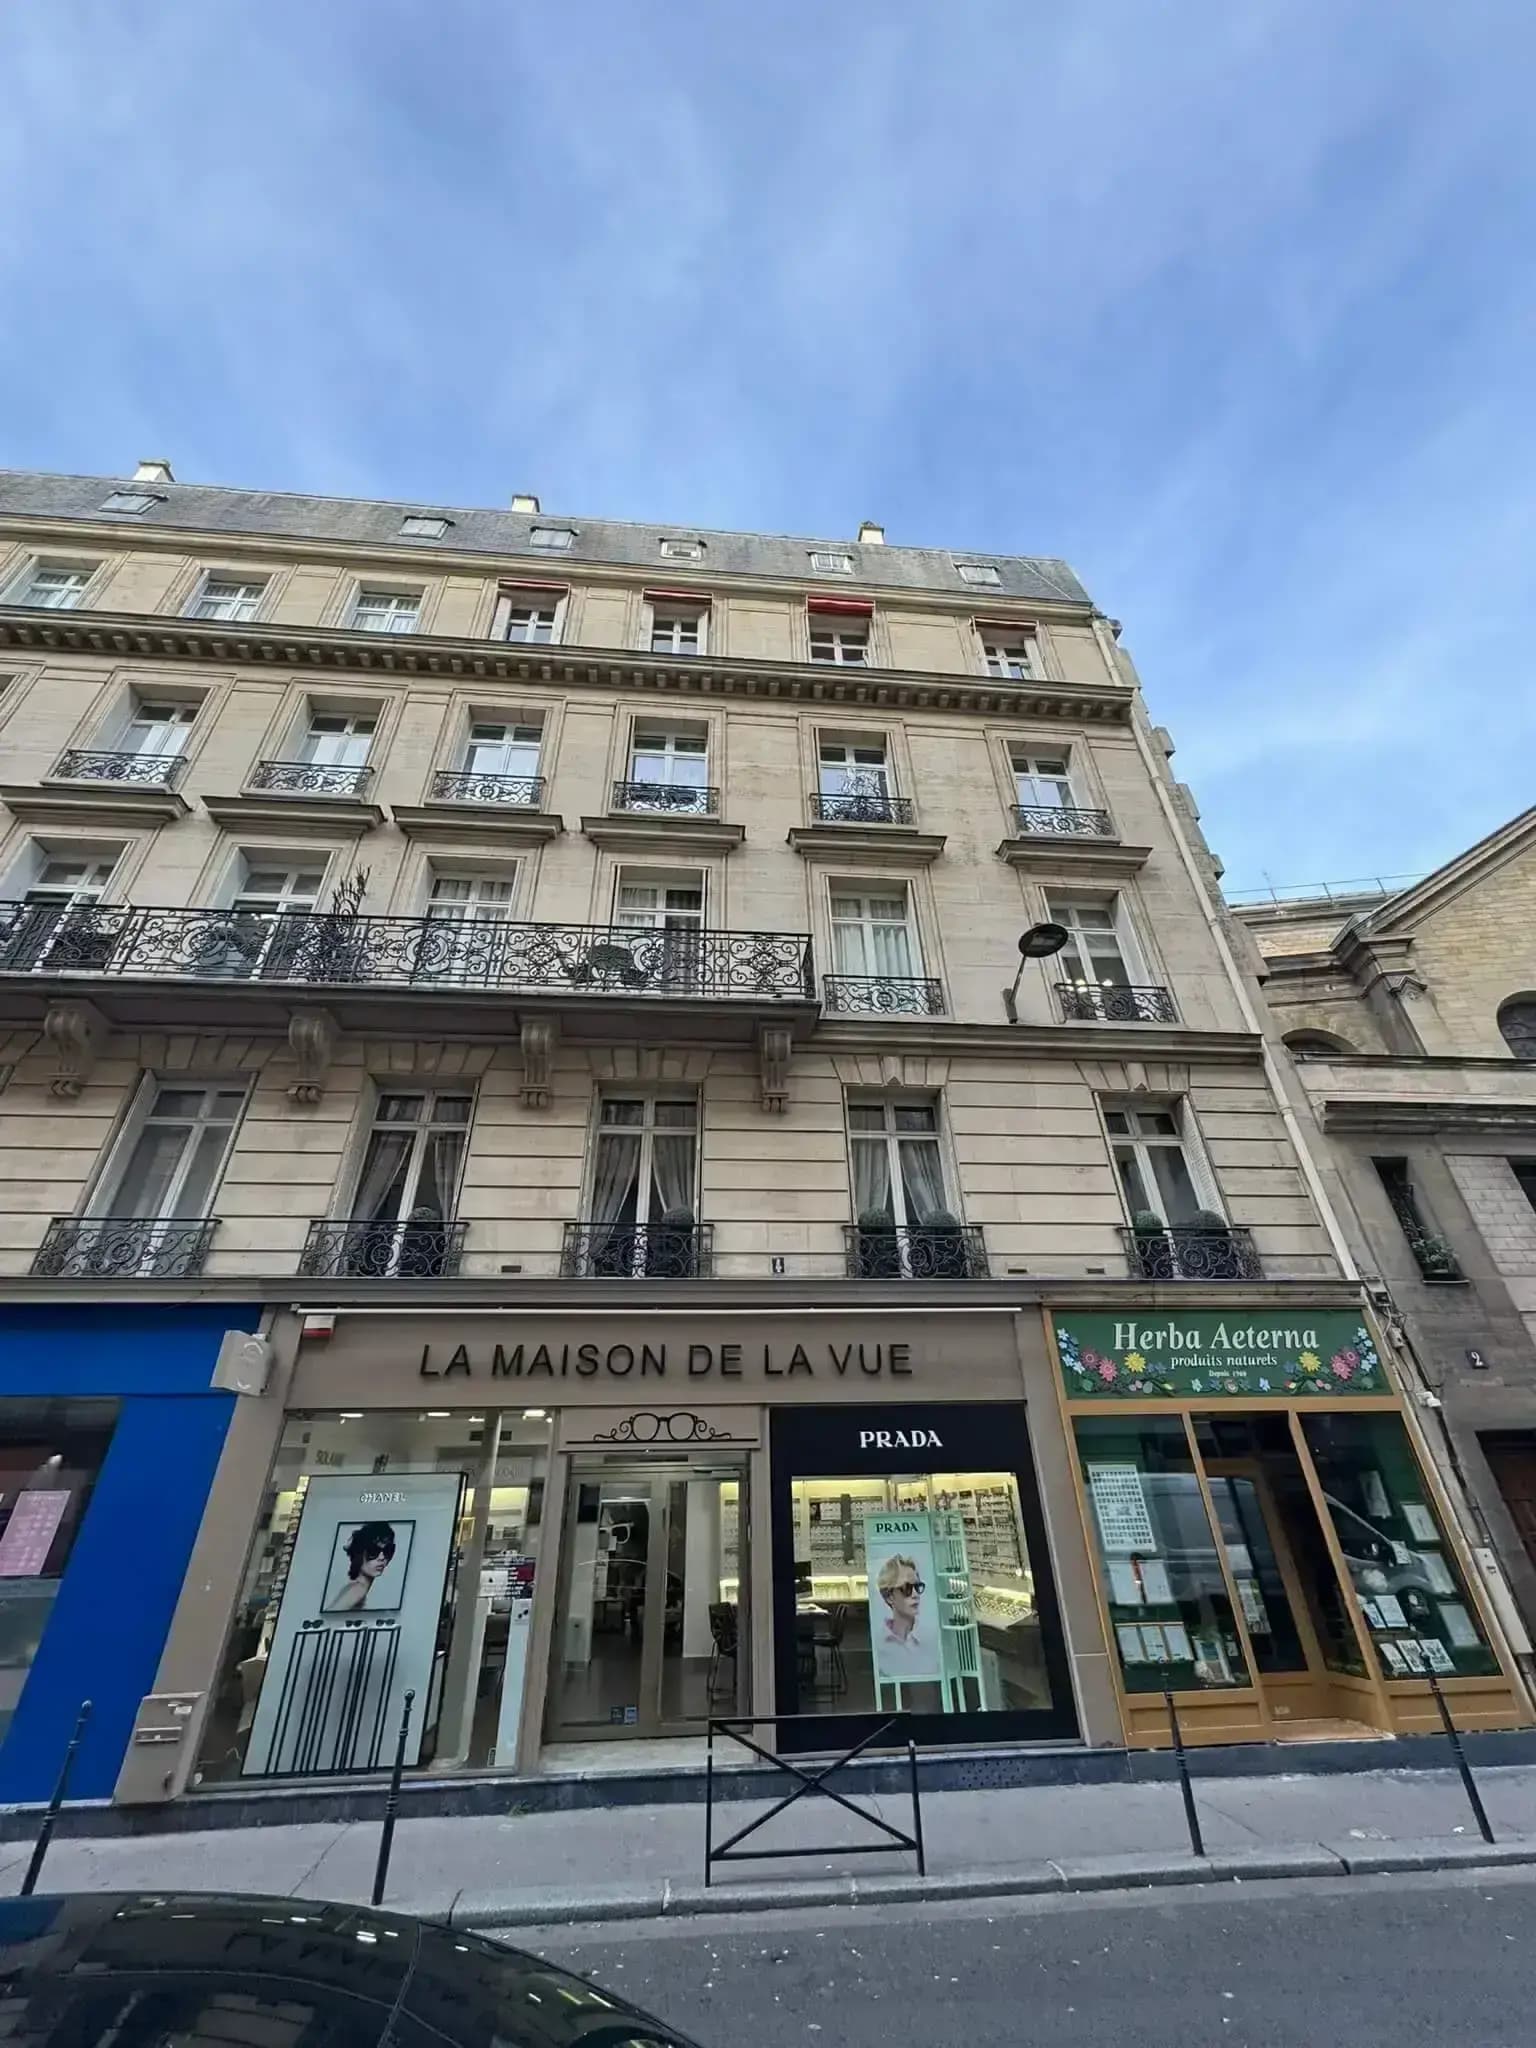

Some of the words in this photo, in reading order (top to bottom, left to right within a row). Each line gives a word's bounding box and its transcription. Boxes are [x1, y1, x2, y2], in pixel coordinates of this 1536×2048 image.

[1113, 1322, 1202, 1351] Herba
[1210, 1322, 1320, 1350] Aeterna
[419, 1343, 473, 1377] LA
[491, 1343, 667, 1377] MAISON
[688, 1343, 743, 1376] DE
[764, 1343, 814, 1376] LA
[828, 1343, 913, 1376] VUE
[1171, 1354, 1223, 1369] produits
[1227, 1353, 1278, 1367] naturels
[1470, 1351, 1484, 1366] 2
[859, 1429, 944, 1449] PRADA
[359, 1491, 406, 1503] CHANEL
[875, 1521, 919, 1533] PRADA
